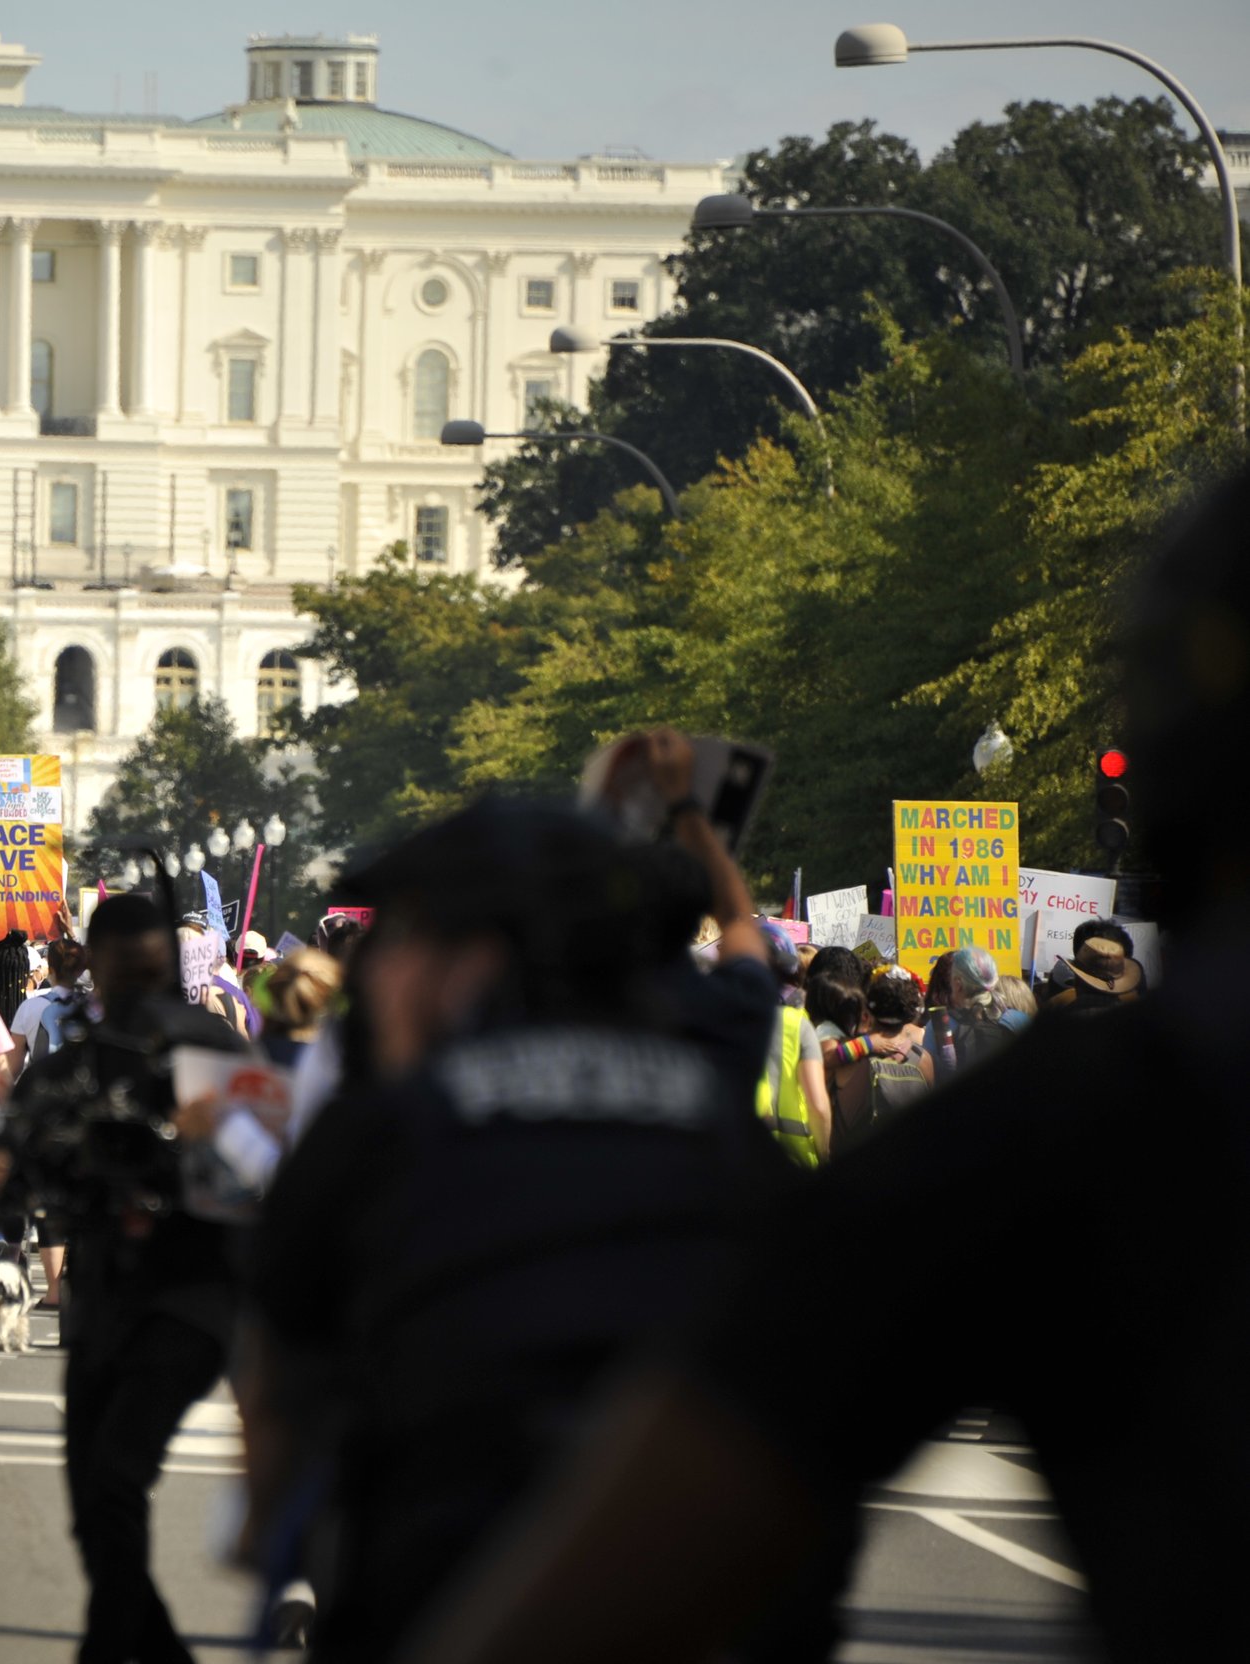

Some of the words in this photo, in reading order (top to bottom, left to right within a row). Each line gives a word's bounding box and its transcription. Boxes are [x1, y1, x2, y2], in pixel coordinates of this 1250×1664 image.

[0, 808, 28, 818] FUNDED
[901, 807, 1015, 830] MARCHED
[911, 836, 935, 857] IN
[949, 837, 1004, 859] 1986
[900, 863, 950, 886] WHY
[955, 865, 990, 886] AM
[1002, 865, 1009, 886] I
[1019, 875, 1035, 889] DY
[899, 896, 1019, 919] MARCHING
[901, 927, 974, 951] AGAIN
[988, 928, 1012, 951] IN
[183, 943, 212, 966] BANS
[183, 963, 205, 984] OFF
